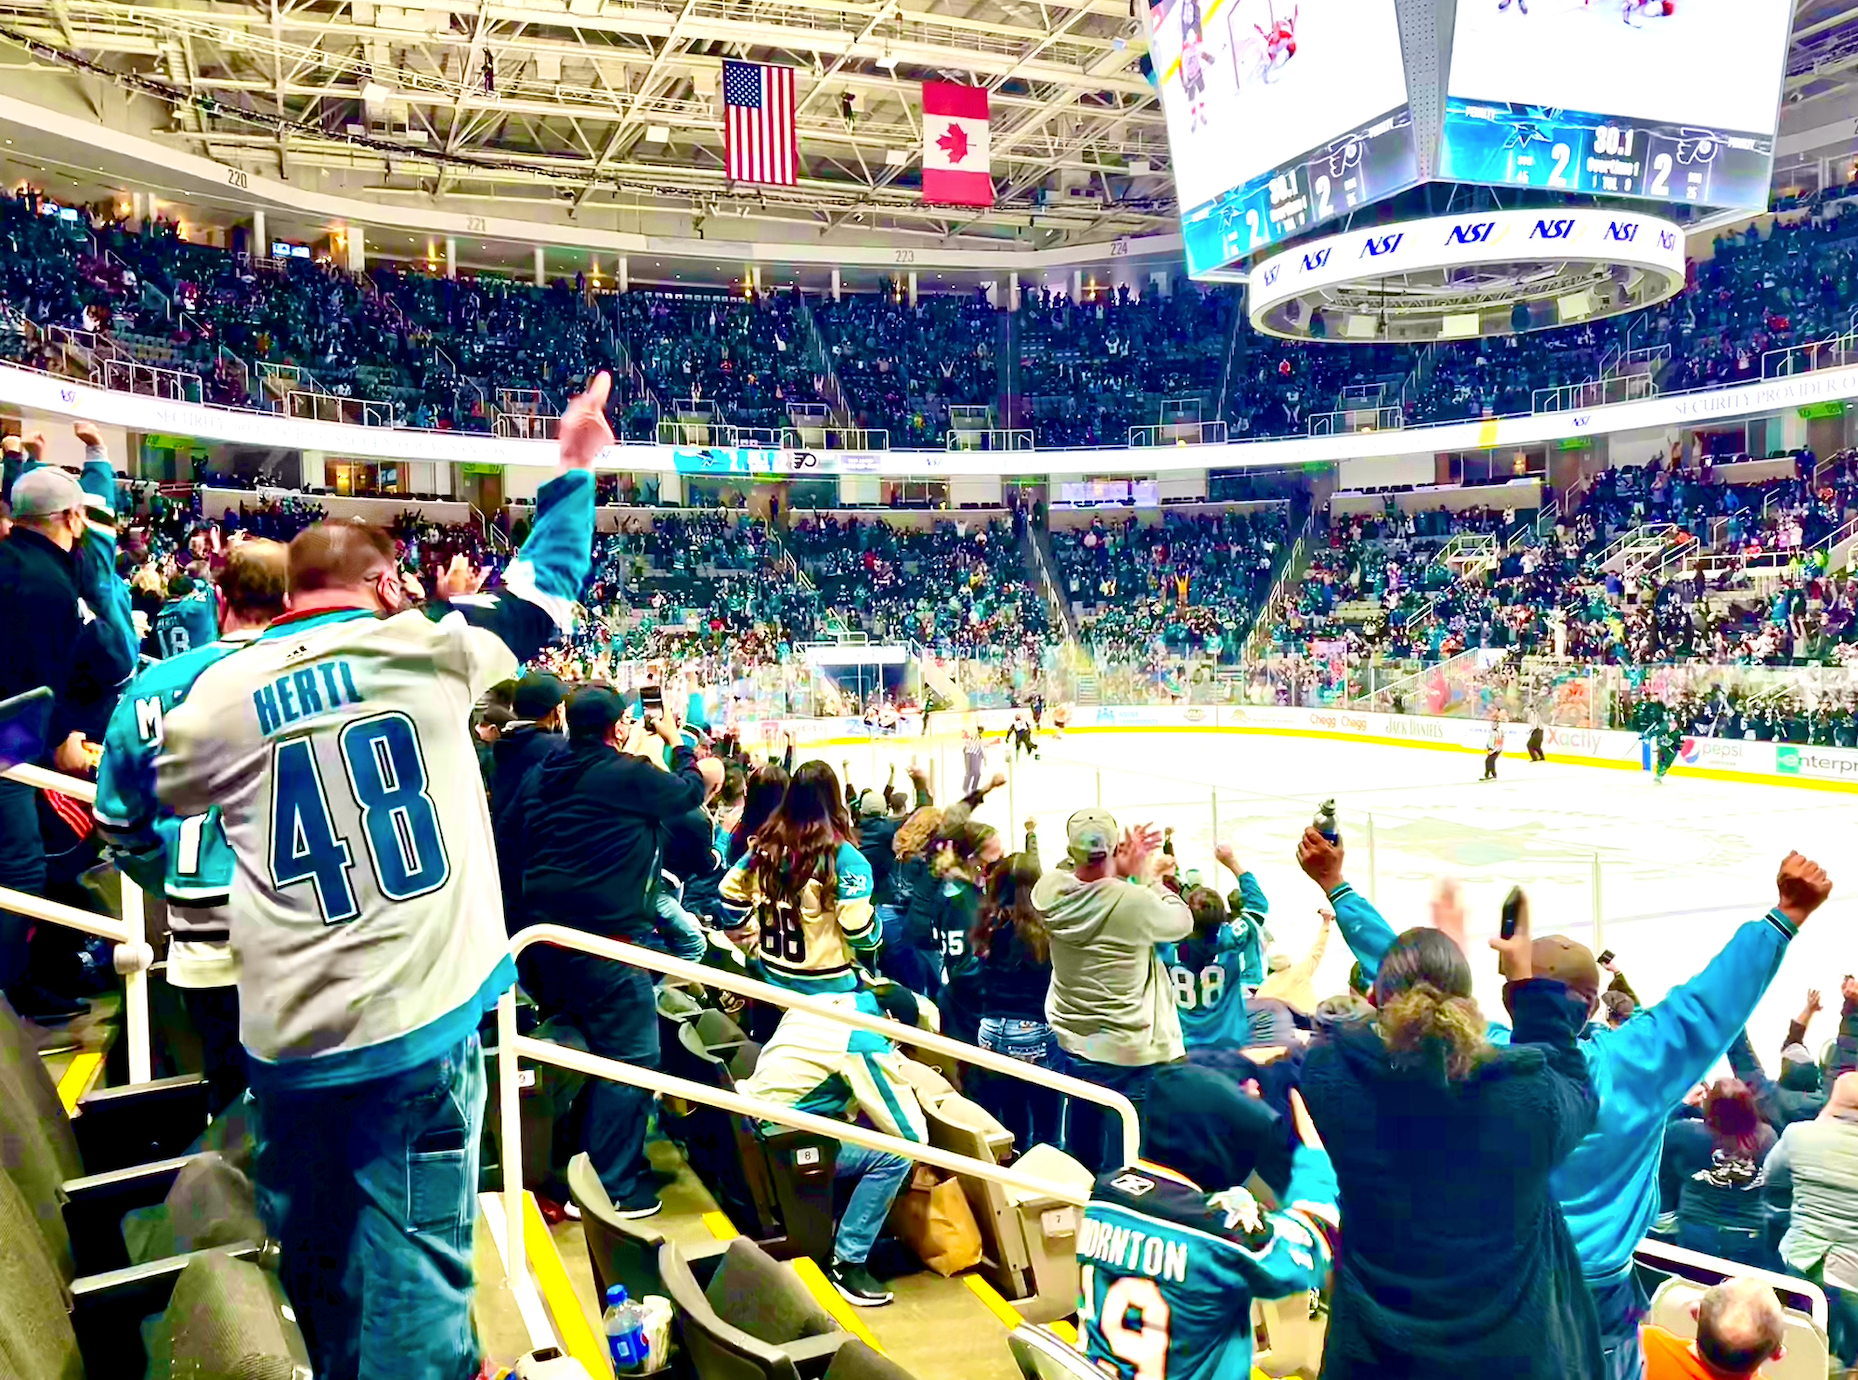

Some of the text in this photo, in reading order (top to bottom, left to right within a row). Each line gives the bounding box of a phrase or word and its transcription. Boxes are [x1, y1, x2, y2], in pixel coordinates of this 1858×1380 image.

[1594, 125, 1634, 156] 30.1
[1548, 143, 1571, 188] 2
[1651, 153, 1673, 196] 2
[228, 169, 248, 189] 220
[1315, 175, 1334, 219] 2
[466, 217, 486, 232] 221
[1246, 209, 1263, 248] 2
[1445, 222, 1496, 247] NSI
[1529, 219, 1576, 240] NSI
[1603, 221, 1640, 243] NSI
[1110, 242, 1128, 255] 224
[1359, 233, 1404, 259] NSI
[1656, 229, 1676, 251] NSI
[895, 250, 915, 263] 223
[1299, 247, 1332, 274] NSI
[1675, 395, 1750, 415] SECURITY
[1756, 378, 1836, 404] PROVIDER
[253, 660, 364, 736] HERTL
[1310, 713, 1336, 728] Chegg
[1386, 717, 1407, 736] JACK
[1546, 728, 1602, 755] Xactly
[1702, 743, 1743, 758] pepsi
[268, 710, 450, 926] 48
[1170, 965, 1226, 1010] 88
